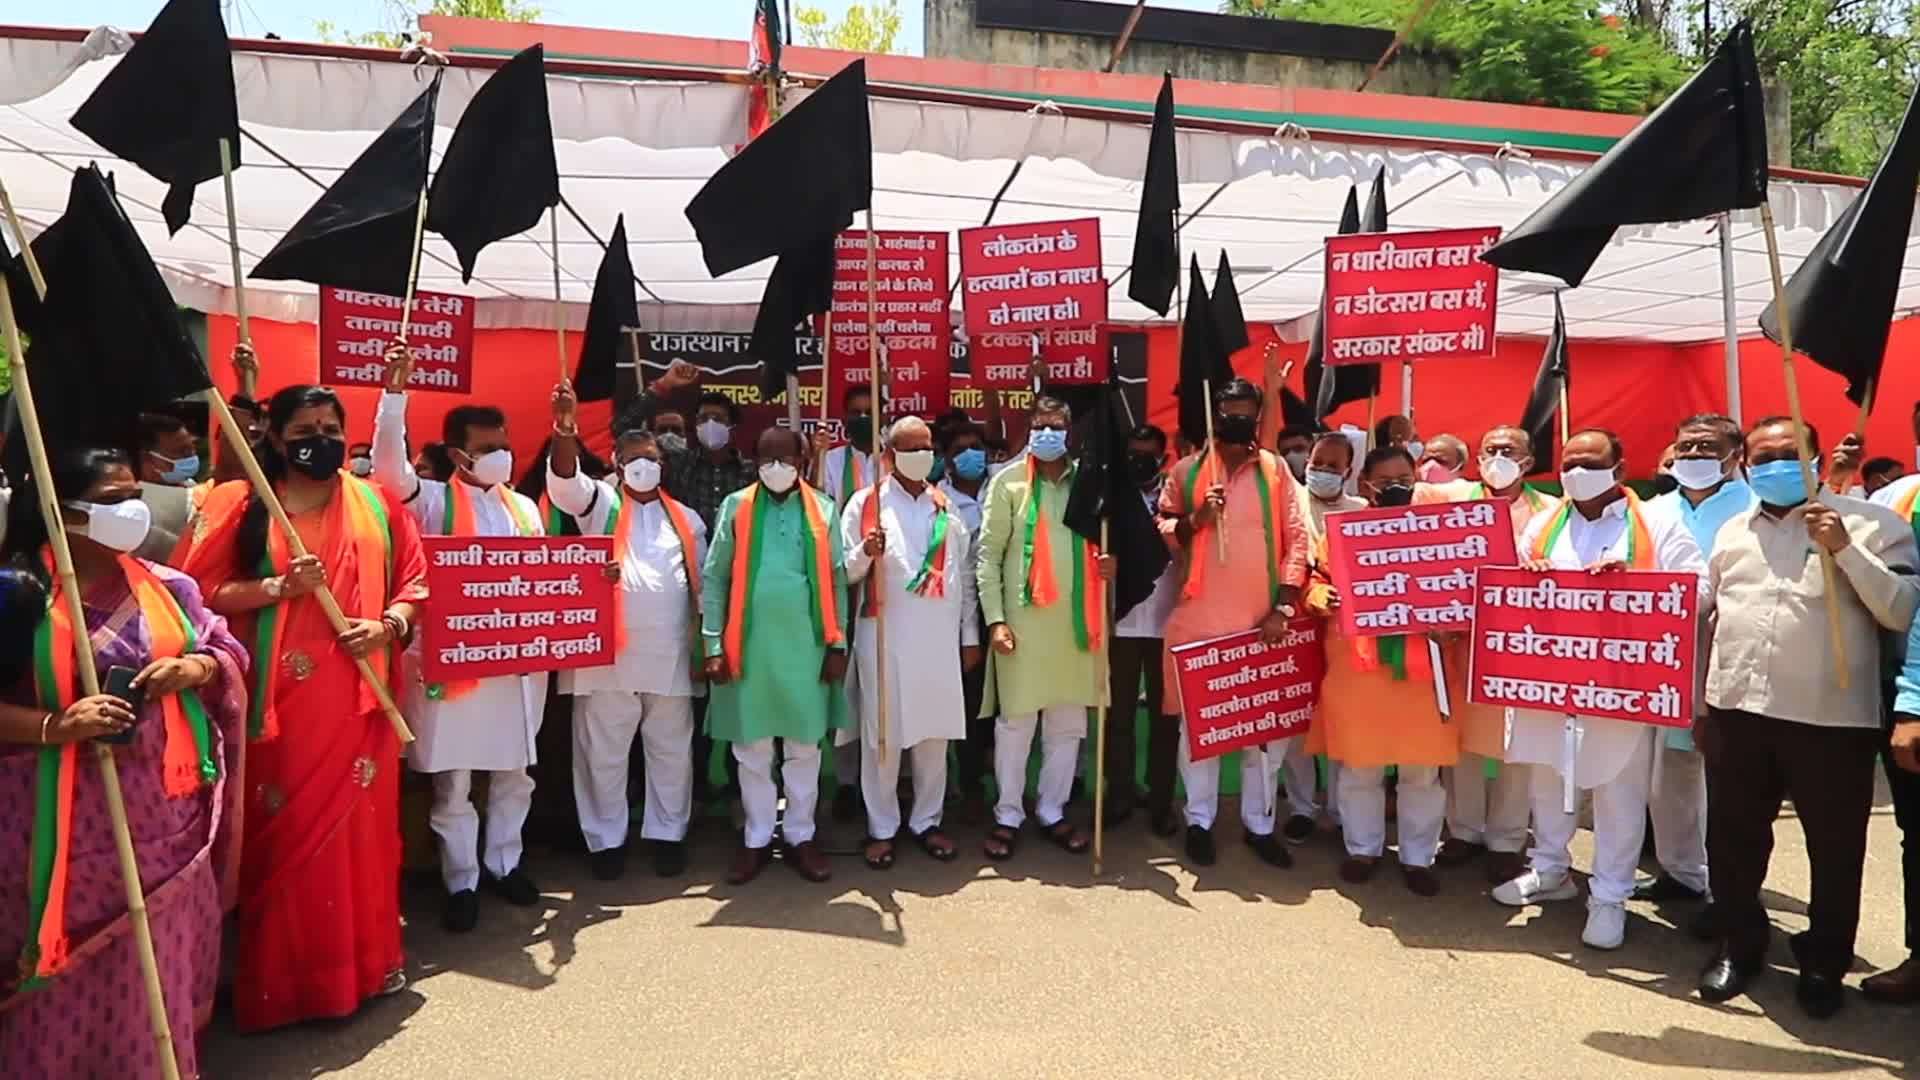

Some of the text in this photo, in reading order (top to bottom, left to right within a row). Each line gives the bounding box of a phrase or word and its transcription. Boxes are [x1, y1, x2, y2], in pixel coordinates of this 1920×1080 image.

[982, 229, 1077, 257] लोकतंत्र के
[1332, 253, 1349, 272] न
[1352, 241, 1433, 271] धारीवाल
[1436, 246, 1471, 267] बस
[967, 266, 1098, 293] हत्यारों का नाश
[424, 296, 463, 315] तेरी
[988, 297, 1079, 325] हो नाश हो।
[1334, 280, 1487, 315] न डोटसरा बस में,
[651, 334, 739, 352] राजस्थान
[1332, 336, 1402, 359] सरकार
[1405, 328, 1459, 355] संकट
[1340, 503, 1495, 536] गहलोत तेरी
[433, 544, 607, 567] आधी रात को महिला
[1355, 535, 1488, 566] तानाशाही
[462, 574, 583, 598] महापौर हटाई,
[1352, 572, 1411, 596] नहीं
[1483, 578, 1688, 619] न धारीवाल बस में,
[446, 608, 516, 630] गहलोत
[1353, 602, 1413, 627] नहीं
[440, 632, 601, 664] लोकतंत्र की दुहाई।
[1221, 646, 1246, 662] रात
[1485, 624, 1681, 670] न डोटसरा बस में,
[1200, 695, 1250, 719] गहलोत
[1482, 676, 1680, 718] सरकार संकट में।
[1198, 722, 1254, 746] लोकतंत्र
[1256, 711, 1277, 731] की
